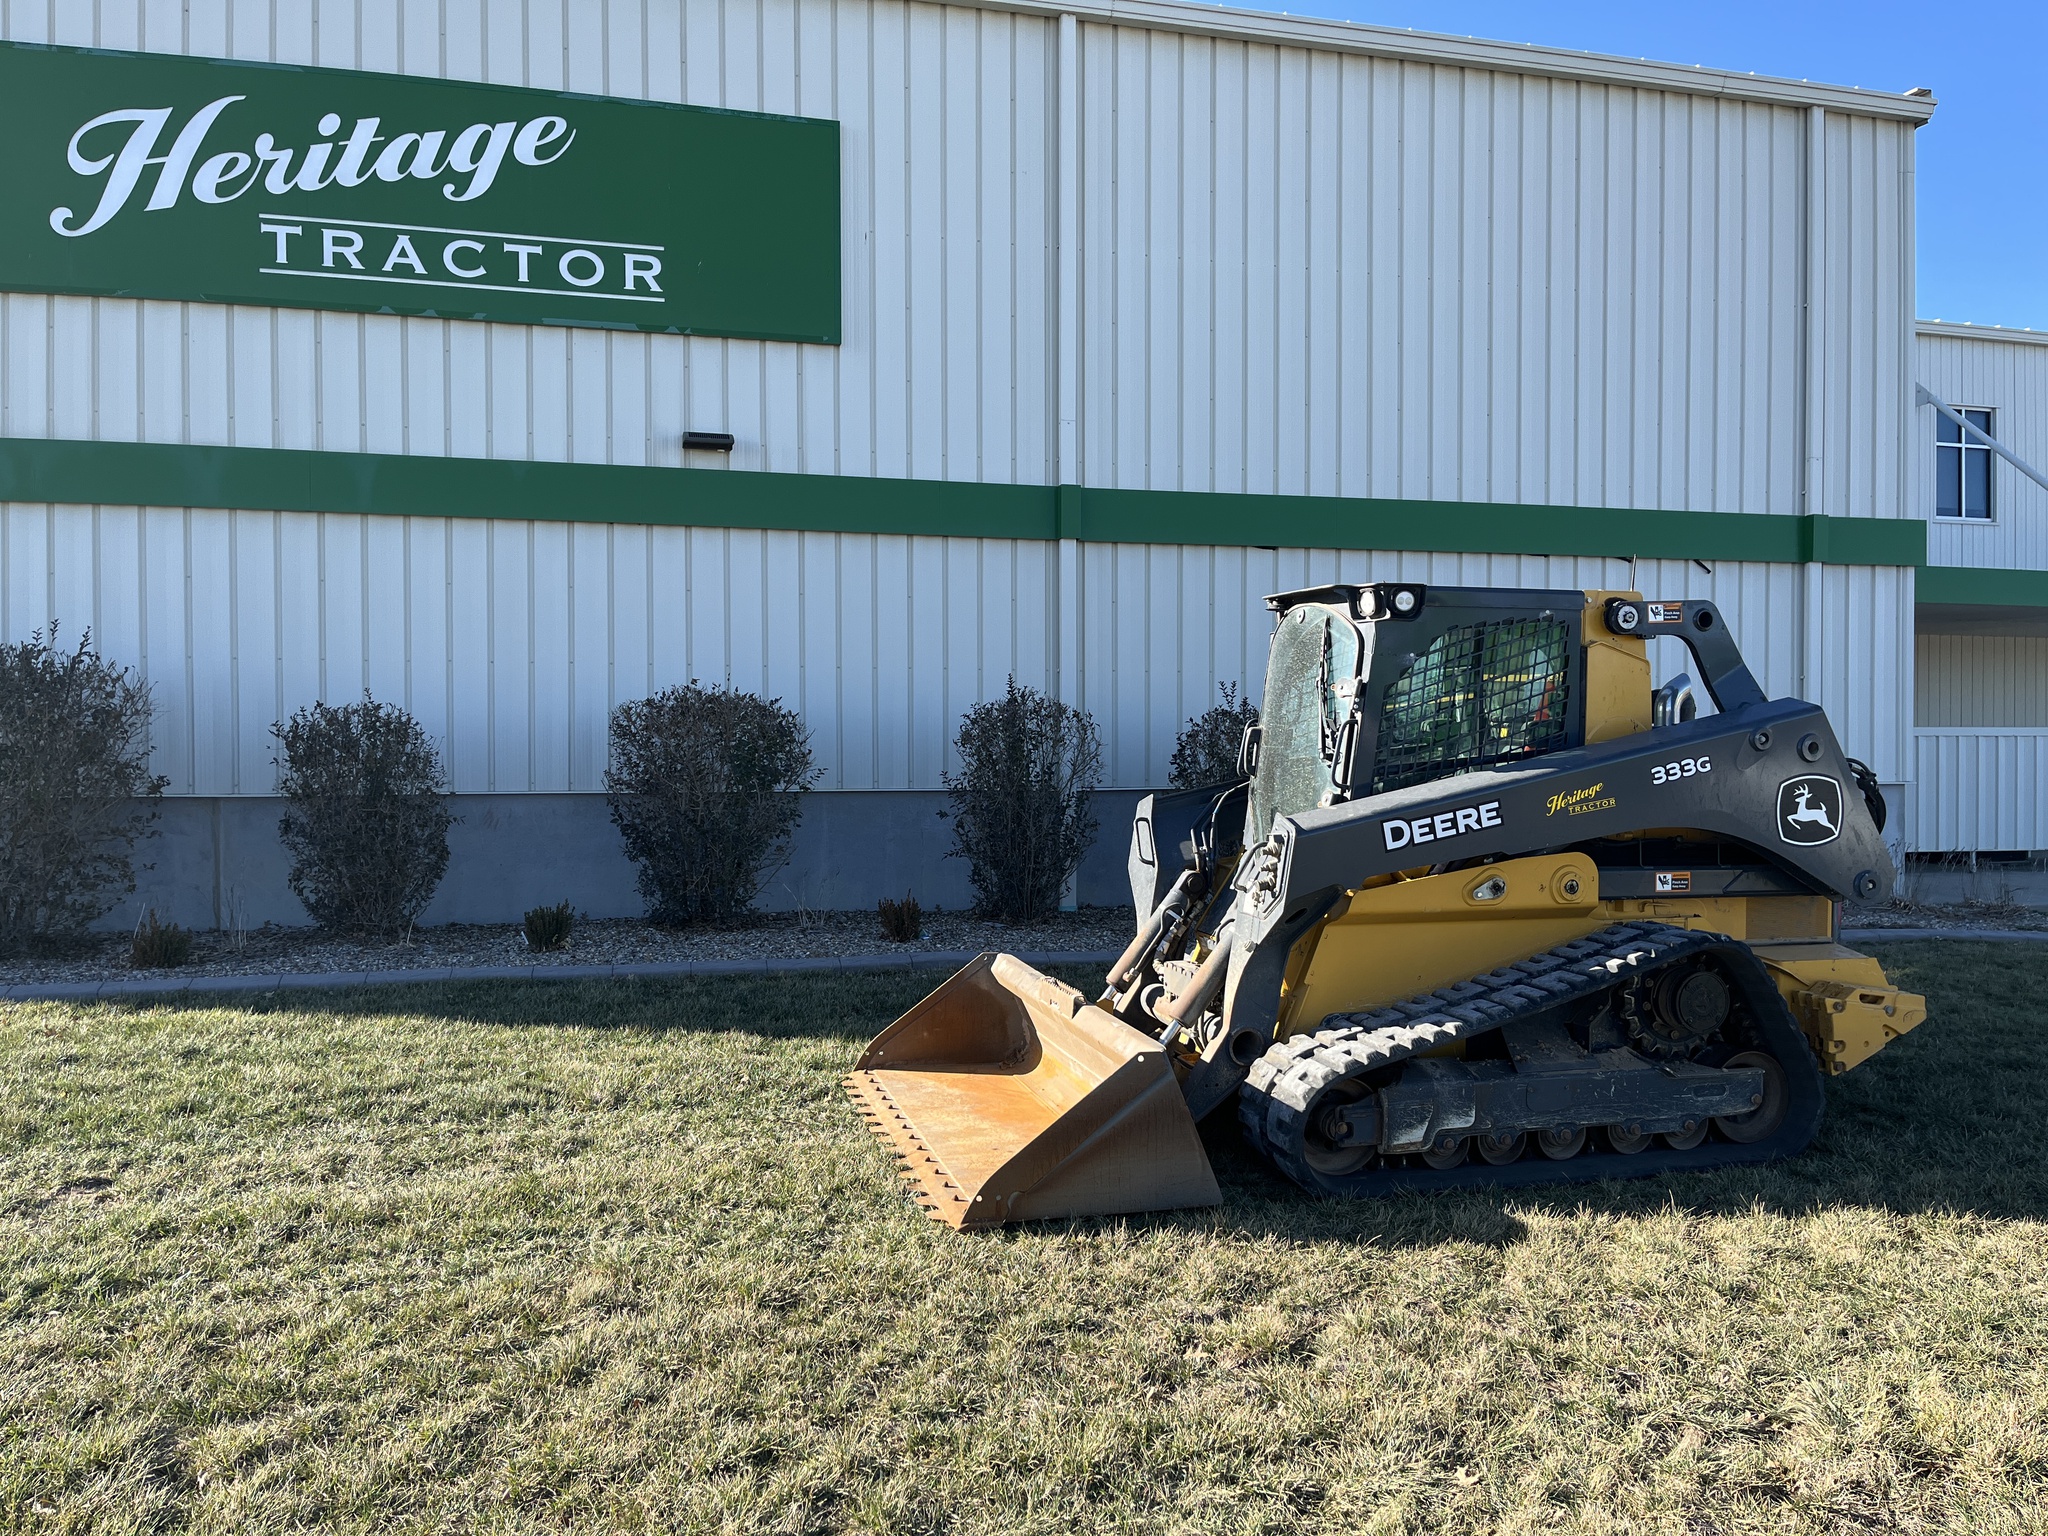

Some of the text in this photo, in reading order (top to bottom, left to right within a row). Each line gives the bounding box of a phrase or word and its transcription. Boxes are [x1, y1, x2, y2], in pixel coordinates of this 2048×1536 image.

[49, 95, 576, 237] Heritage
[259, 221, 664, 293] TRACTOR
[1651, 757, 1712, 785] 333G
[1546, 783, 1604, 817] Heritage
[1568, 799, 1616, 814] TRACTOR
[1382, 801, 1502, 850] DEERE
